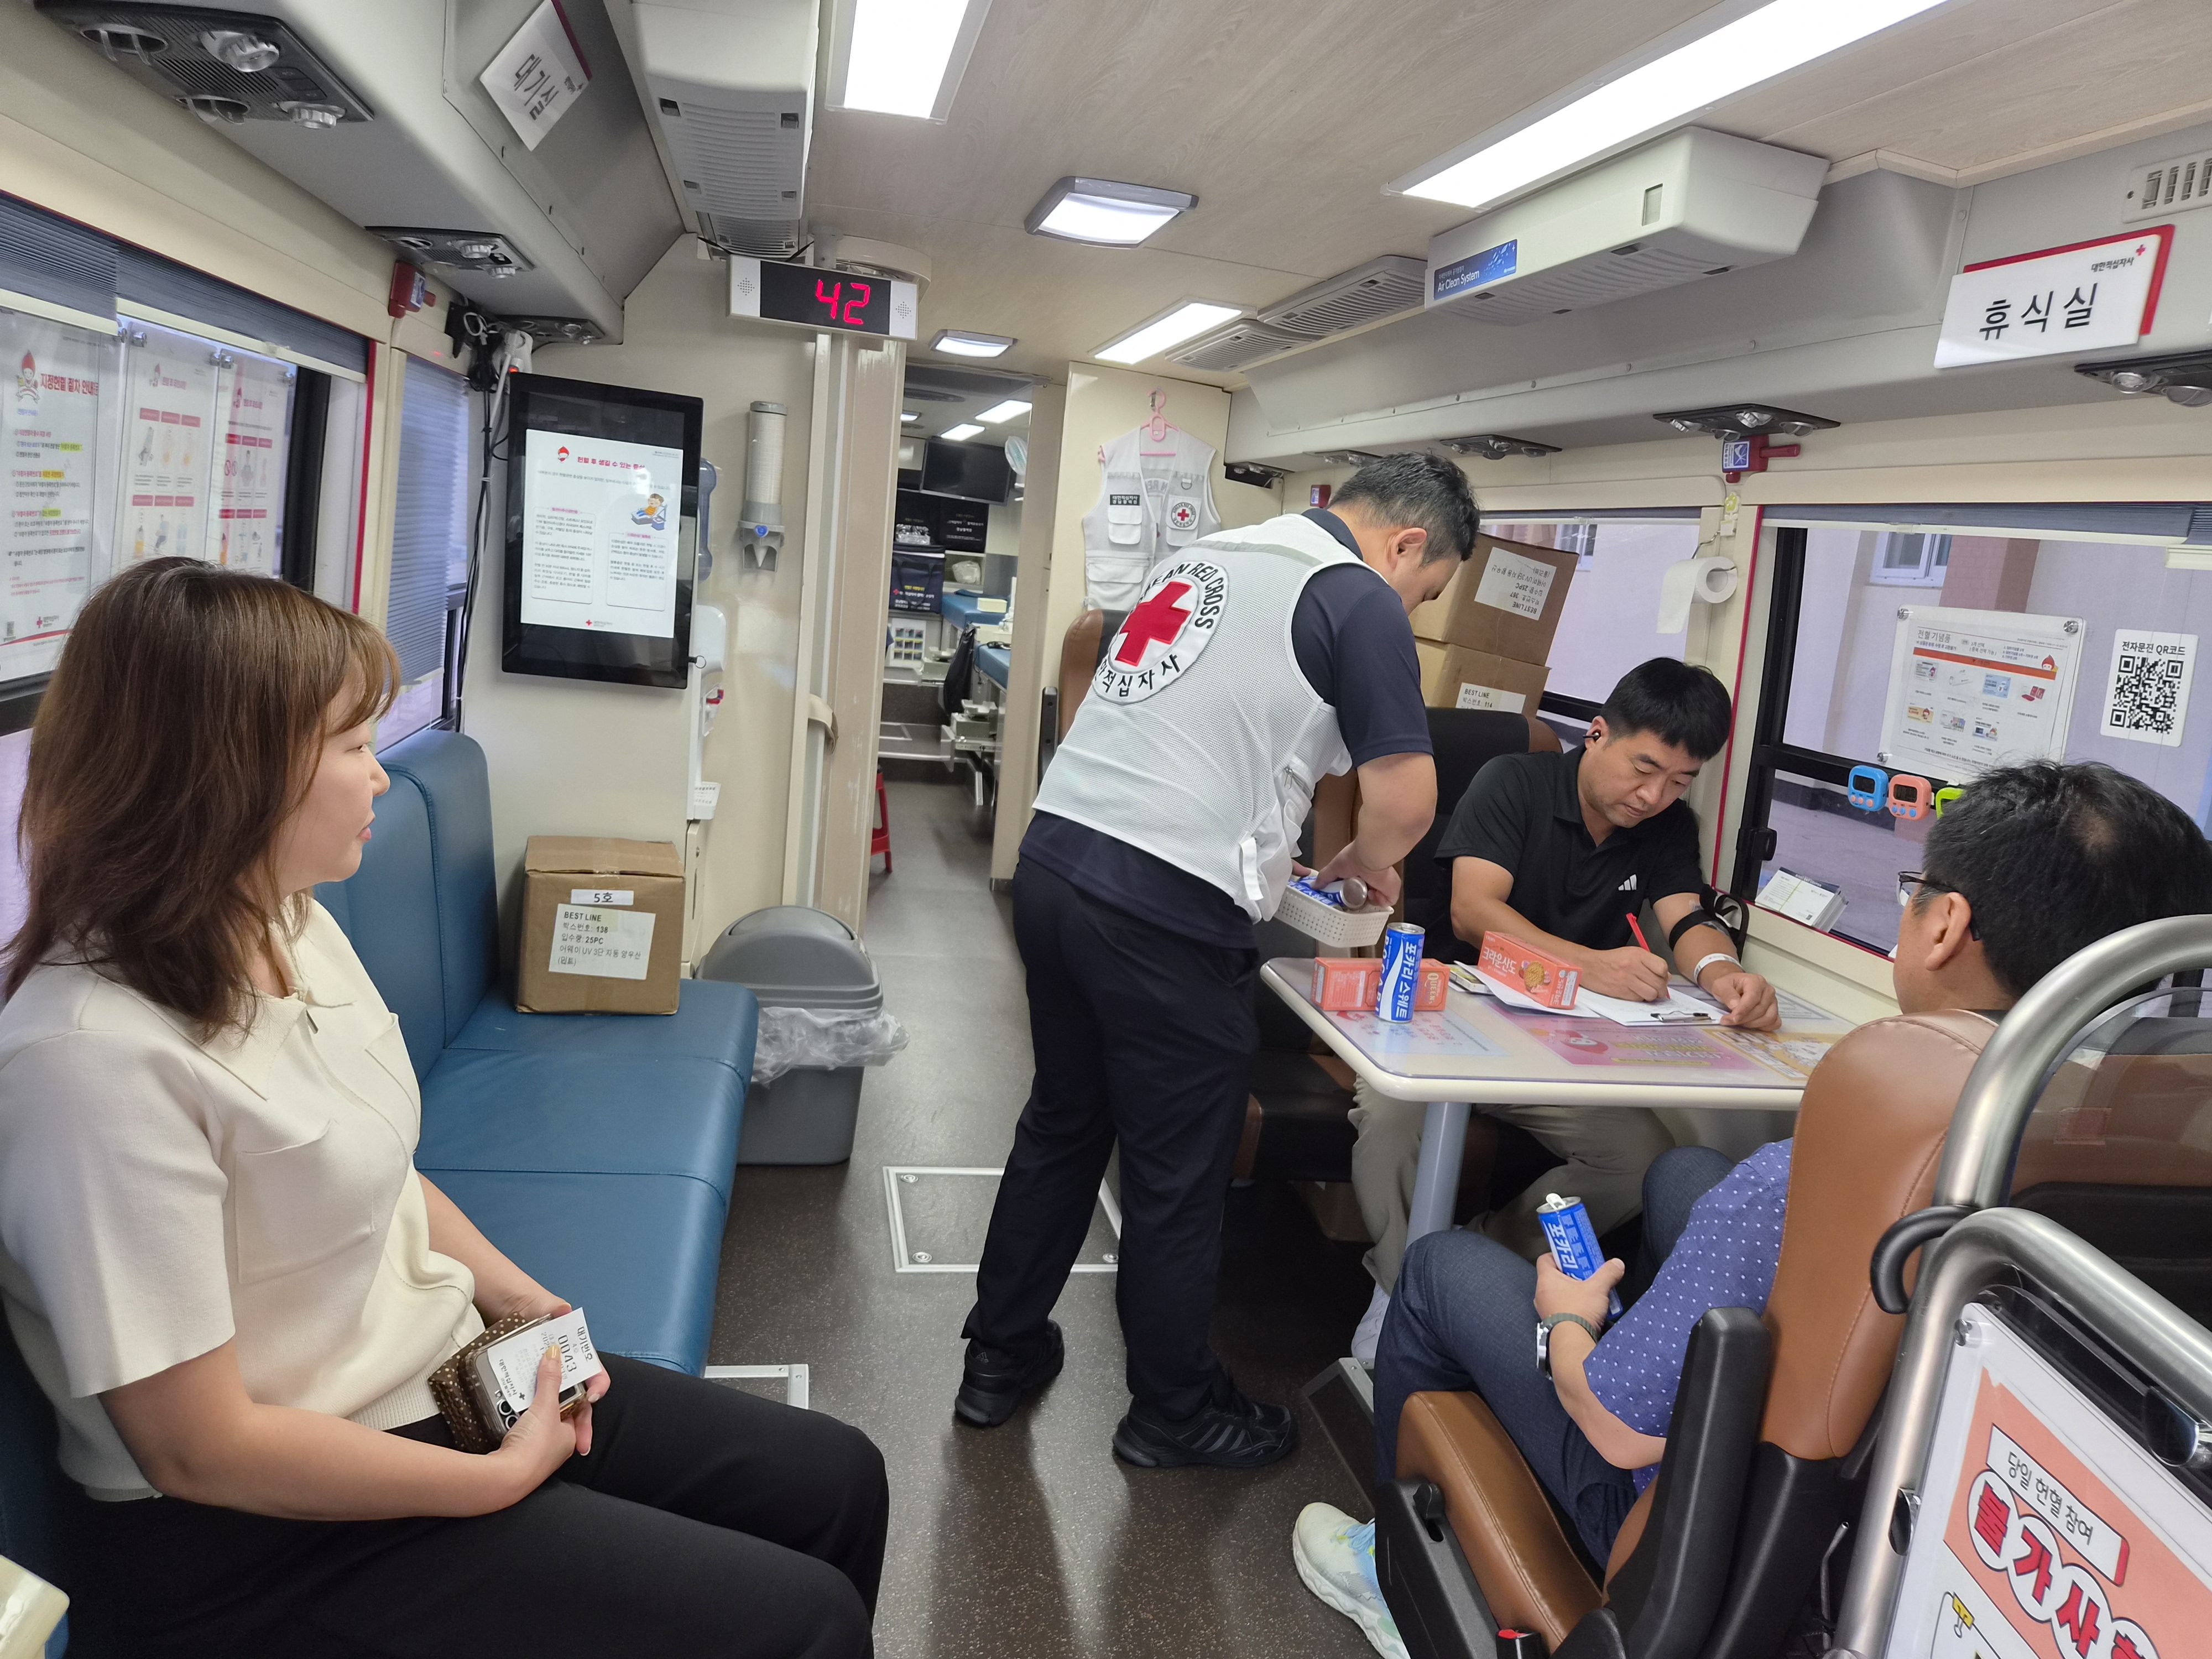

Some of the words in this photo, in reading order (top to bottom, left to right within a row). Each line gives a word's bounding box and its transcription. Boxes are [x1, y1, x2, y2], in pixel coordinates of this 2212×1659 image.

[514, 54, 560, 121] 대기실
[2090, 256, 2135, 273] 대한적십자사
[1437, 281, 1446, 293] Air
[1445, 277, 1460, 290] Clean
[1460, 270, 1480, 286] System
[815, 279, 871, 325] 42
[1979, 282, 2099, 341] 휴식실
[1188, 562, 1219, 582] RED
[1515, 582, 1528, 592] 25PC
[1194, 577, 1224, 629] CROSS
[1512, 601, 1524, 610] LINE
[1524, 606, 1537, 614] BEST
[1918, 630, 1931, 640] 전혈
[1931, 632, 1951, 643] 기념품
[2122, 641, 2154, 654] 전자문진
[2156, 645, 2185, 655] QR코드
[593, 891, 613, 902] 5호
[563, 922, 593, 933] 박스번호:
[564, 911, 585, 920] BEST
[585, 912, 602, 922] LINE
[561, 933, 584, 943] 입수량:
[585, 936, 603, 945] 25PC
[560, 945, 581, 954] 어웨이
[606, 949, 618, 957] 자동
[621, 950, 641, 960] 양우산
[1401, 941, 1417, 979] 포카리
[1482, 946, 1517, 974] 크라운산도
[1396, 981, 1411, 1019] 스웨트
[1548, 1223, 1579, 1270] 포카리
[558, 1334, 577, 1373] 0043
[577, 1326, 593, 1362] 대기번호
[499, 1359, 518, 1396] 대한적십자사
[2007, 1451, 2033, 1491] 당일
[2035, 1476, 2064, 1519] 헌혈
[2065, 1505, 2094, 1546] 참여
